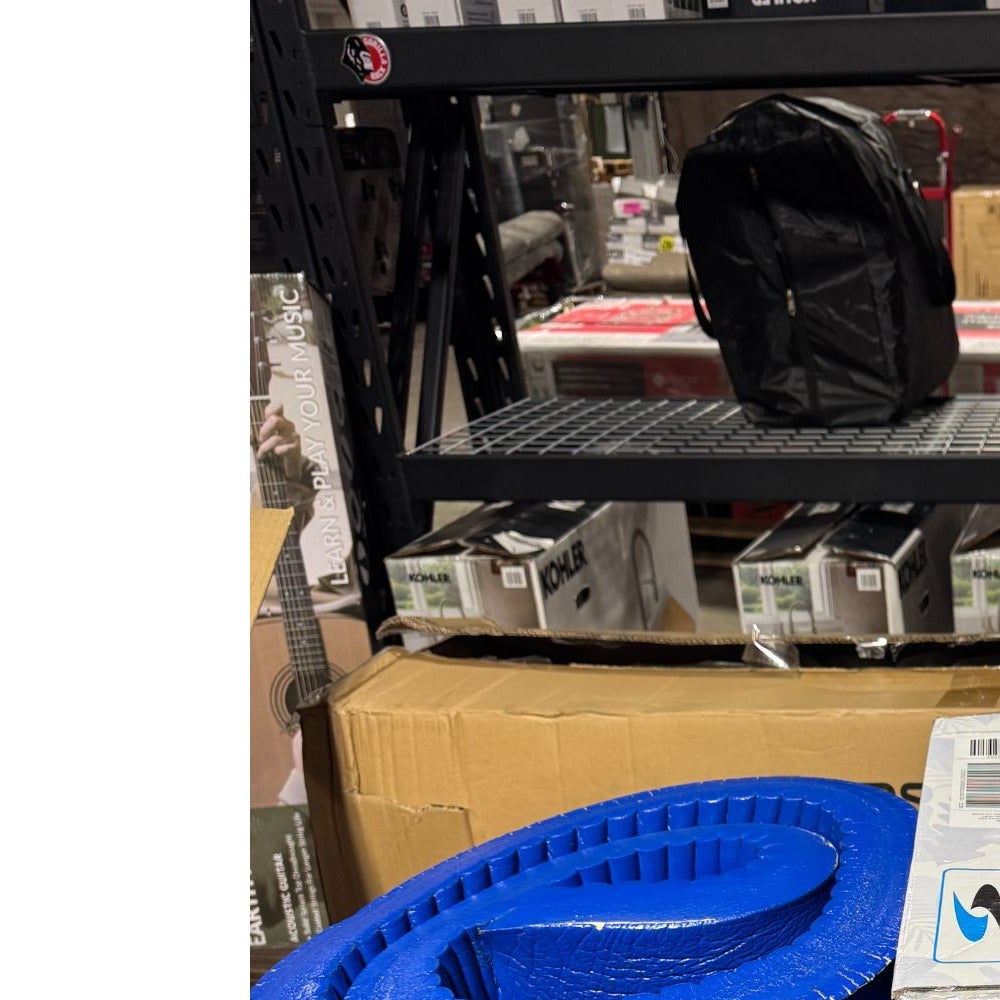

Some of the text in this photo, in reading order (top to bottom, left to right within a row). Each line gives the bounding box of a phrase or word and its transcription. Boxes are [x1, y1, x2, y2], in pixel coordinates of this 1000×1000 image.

[280, 288, 348, 585] LEARN & PLAY YOUR MUSIC
[409, 573, 450, 584] KOHLER
[541, 540, 588, 600] KOHLER
[760, 575, 802, 586] KOHLER
[274, 852, 299, 942] ACOUSTIC GUITAR
